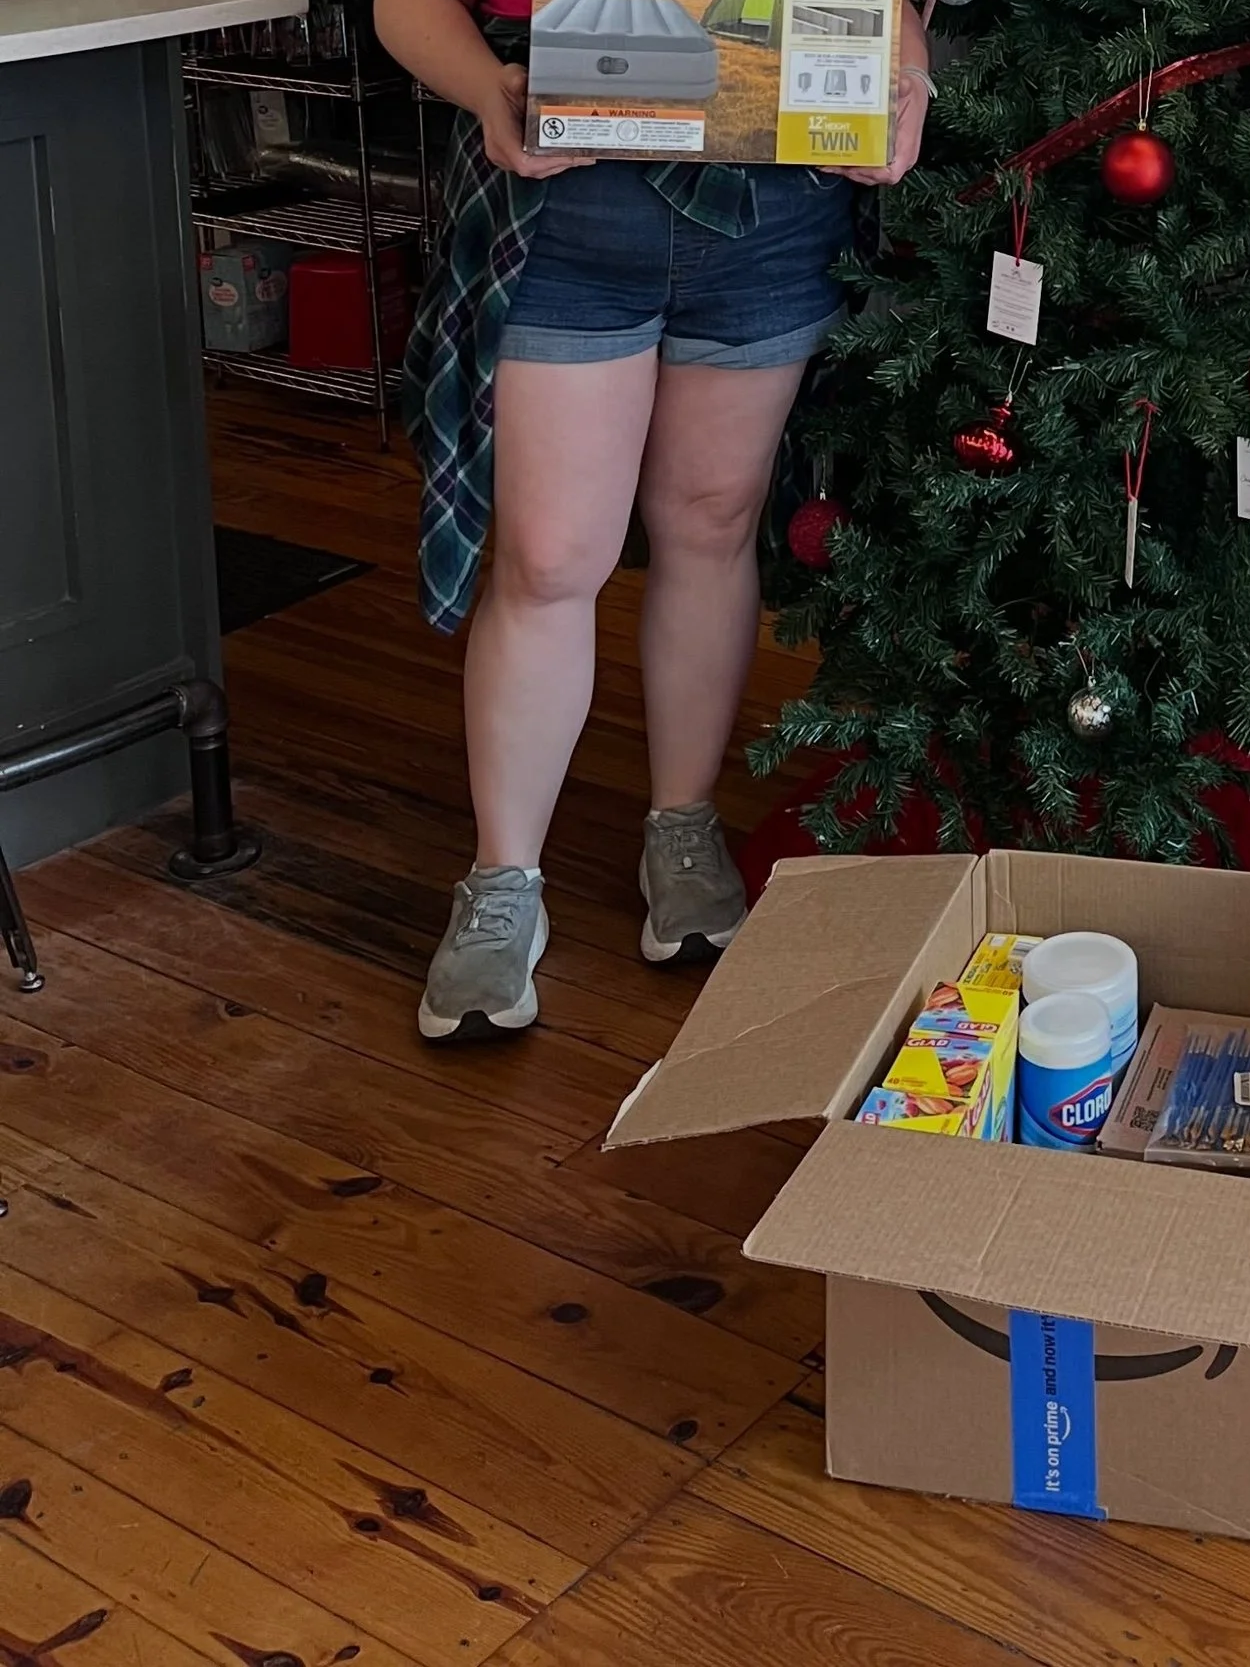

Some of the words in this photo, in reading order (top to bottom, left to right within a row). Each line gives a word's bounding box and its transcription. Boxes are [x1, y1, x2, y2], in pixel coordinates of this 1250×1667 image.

[608, 109, 656, 118] WARNING
[825, 121, 852, 130] HEIGHT
[808, 131, 859, 151] TWIN
[957, 1022, 998, 1032] GLAD
[907, 1039, 949, 1047] GLAD
[1044, 1333, 1057, 1365] now
[1044, 1366, 1057, 1396] and
[1044, 1400, 1062, 1445] prime
[1046, 1445, 1060, 1466] on
[1045, 1468, 1061, 1492] It's
